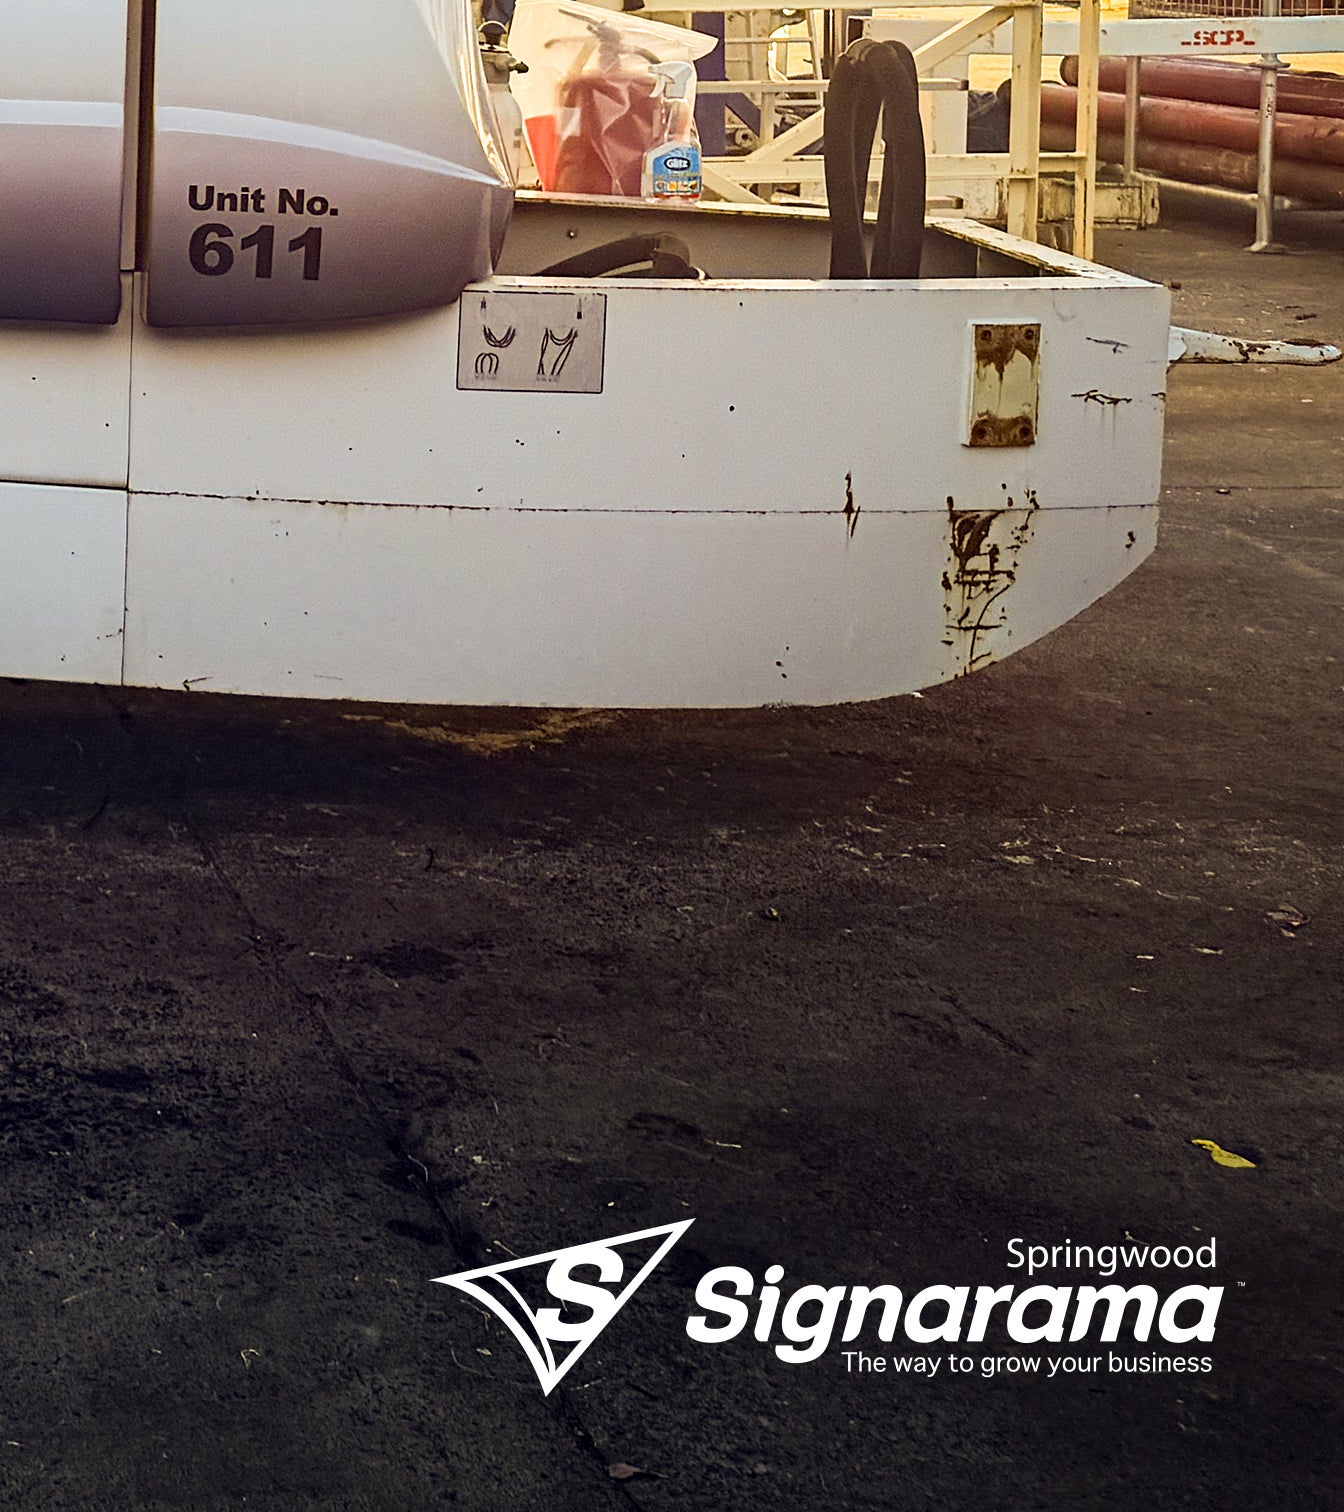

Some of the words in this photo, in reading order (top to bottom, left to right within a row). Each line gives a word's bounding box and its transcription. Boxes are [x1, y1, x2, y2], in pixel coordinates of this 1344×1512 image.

[187, 184, 266, 215] Unit
[277, 188, 340, 217] No.
[187, 223, 323, 282] 611
